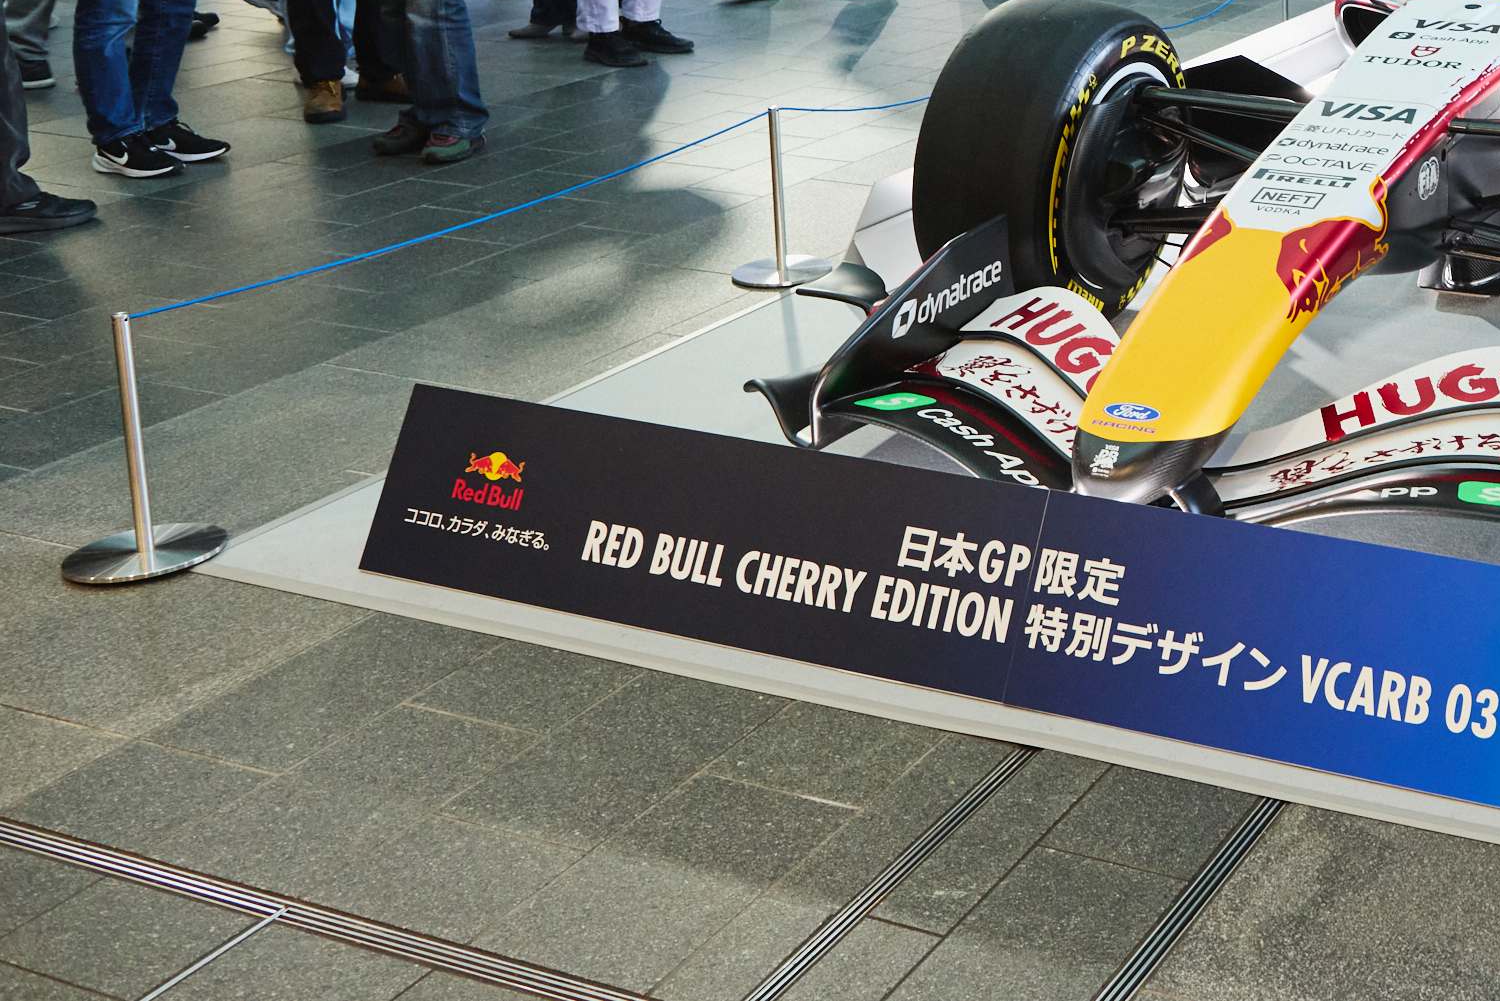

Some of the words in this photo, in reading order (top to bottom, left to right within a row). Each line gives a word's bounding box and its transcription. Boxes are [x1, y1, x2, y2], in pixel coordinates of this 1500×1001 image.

[1415, 18, 1500, 34] VISA
[1120, 35, 1136, 59] P
[1363, 55, 1462, 70] TUDOR
[1320, 100, 1417, 125] VISA
[1295, 138, 1389, 156] dynatrace
[1283, 154, 1379, 173] OCTAVE
[1252, 168, 1357, 188] PIRELLI
[1260, 190, 1317, 205] NEFT
[1256, 205, 1301, 216] VODKA
[917, 259, 1002, 325] dynatrace
[951, 354, 1075, 451] 翼をさずけ
[1113, 404, 1151, 420] Ford
[1092, 419, 1157, 434] RACING
[917, 408, 995, 447] Cash
[984, 450, 1044, 488] Ap
[451, 477, 489, 505] Red
[486, 485, 524, 511] Bull
[404, 507, 550, 551] ココロ、カラダ、みなぎる。
[581, 519, 645, 570] RED
[649, 532, 724, 588] BULL
[735, 549, 868, 614] CHERRY
[870, 575, 1014, 644] EDITION
[1023, 604, 1288, 692] 特別デザイン
[1299, 654, 1433, 725] VCARB
[1445, 684, 1500, 739] 03
